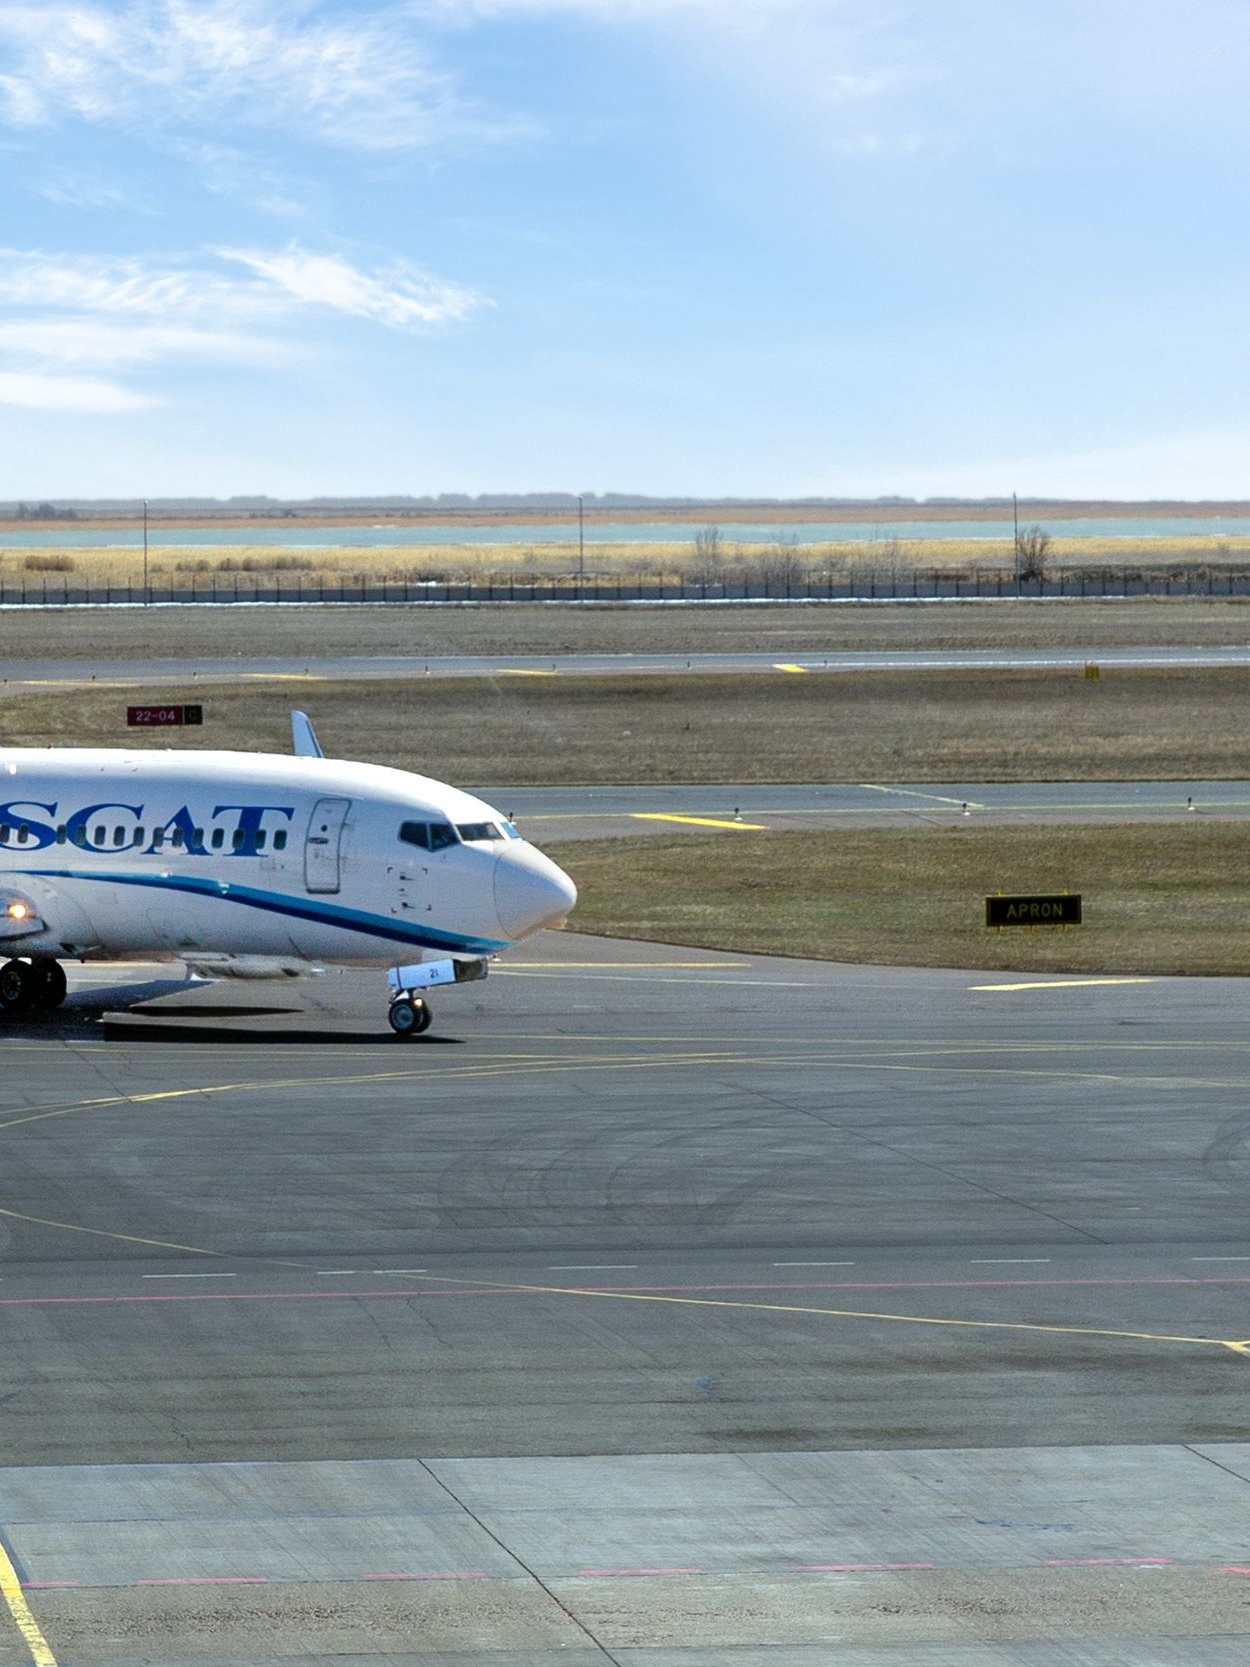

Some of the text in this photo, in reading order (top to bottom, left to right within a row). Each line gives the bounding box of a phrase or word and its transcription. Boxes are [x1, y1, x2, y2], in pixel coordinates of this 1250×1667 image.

[135, 710, 175, 721] 22-04
[1006, 903, 1063, 918] APRON
[430, 968, 439, 979] 21
